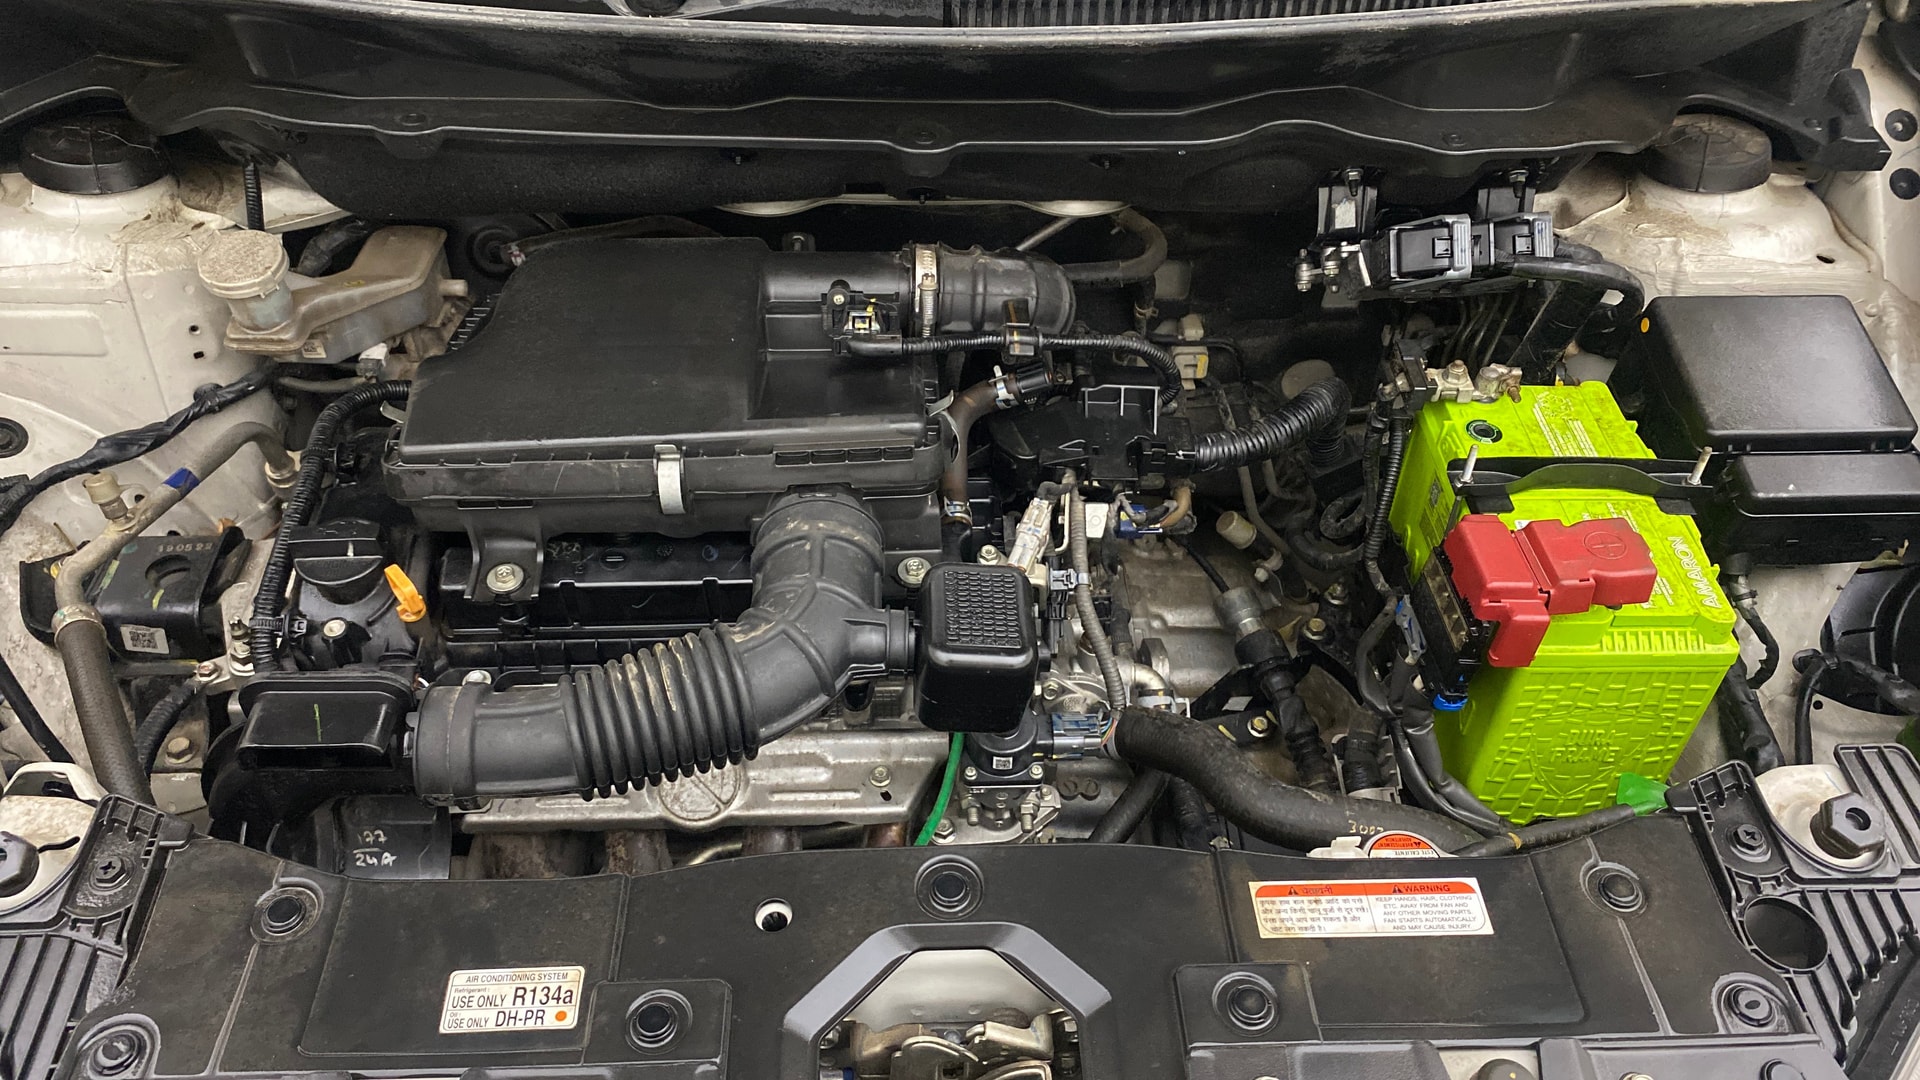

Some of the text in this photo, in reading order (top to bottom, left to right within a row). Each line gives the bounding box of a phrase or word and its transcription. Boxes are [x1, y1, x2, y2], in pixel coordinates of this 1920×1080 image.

[1667, 536, 1722, 609] AMARON
[1565, 729, 1616, 746] DURA
[1550, 747, 1620, 762] FRAME
[1403, 884, 1451, 893] WARNING
[466, 972, 568, 983] AIR CONDITIONING SYSTEM
[452, 985, 574, 1009] USE ONLY R134a
[447, 1009, 546, 1029] USE ONLY DH-PR
